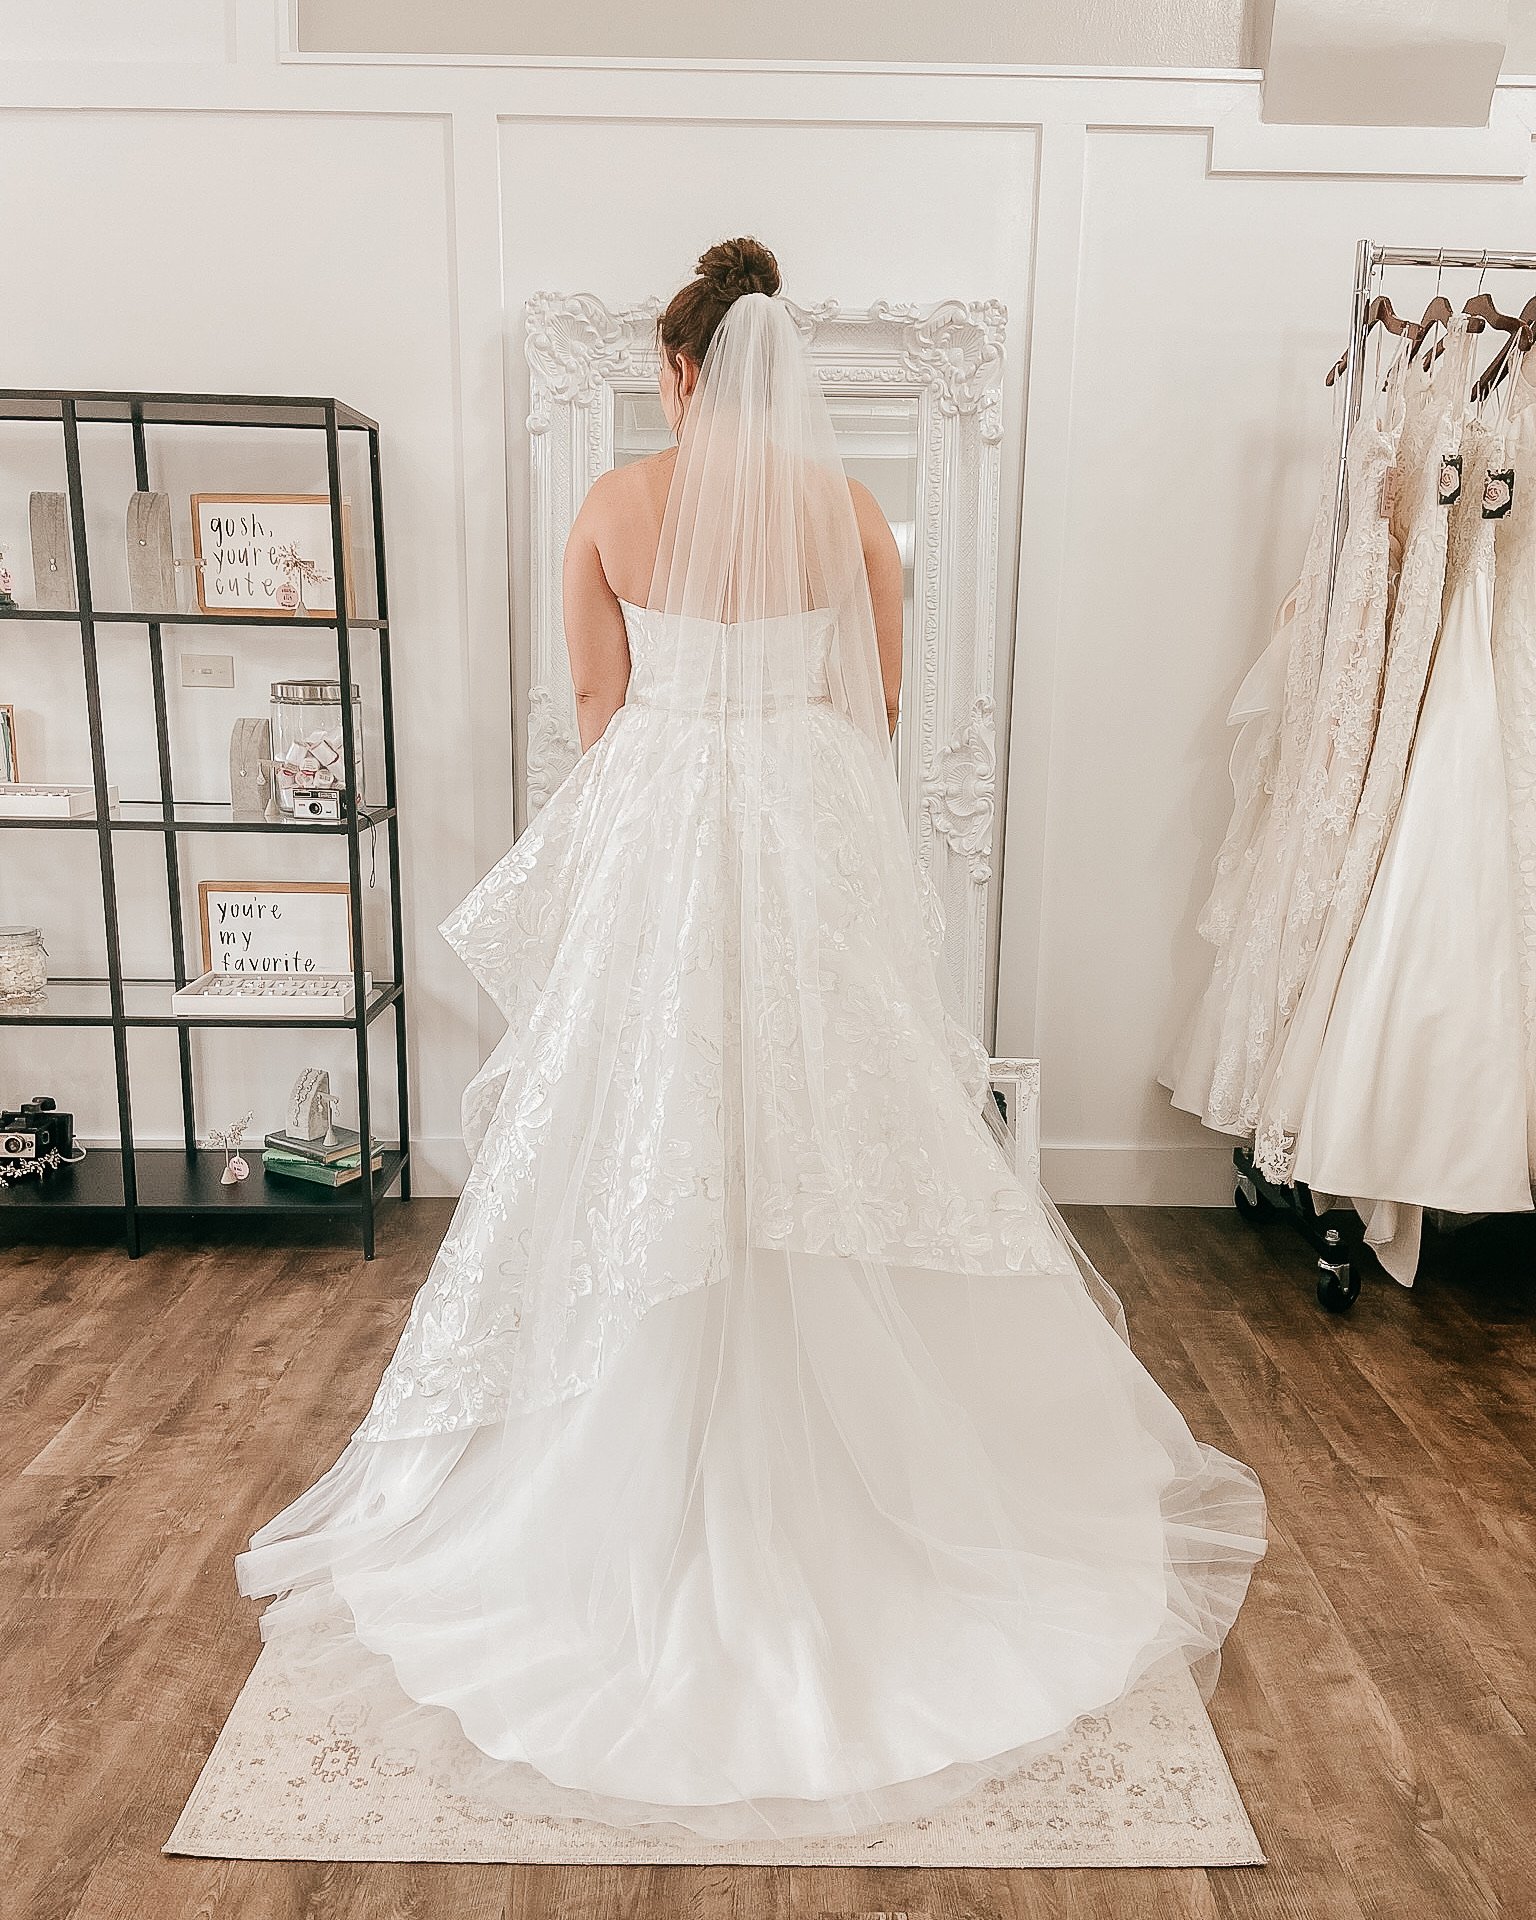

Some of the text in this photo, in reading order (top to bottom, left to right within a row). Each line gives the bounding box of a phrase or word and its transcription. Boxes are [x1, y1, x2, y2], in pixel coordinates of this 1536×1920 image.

[210, 513, 273, 548] gosh,
[213, 541, 278, 574] you're
[215, 572, 276, 597] cute
[217, 896, 282, 924] you're
[219, 930, 252, 952] my
[221, 950, 316, 972] favorite
